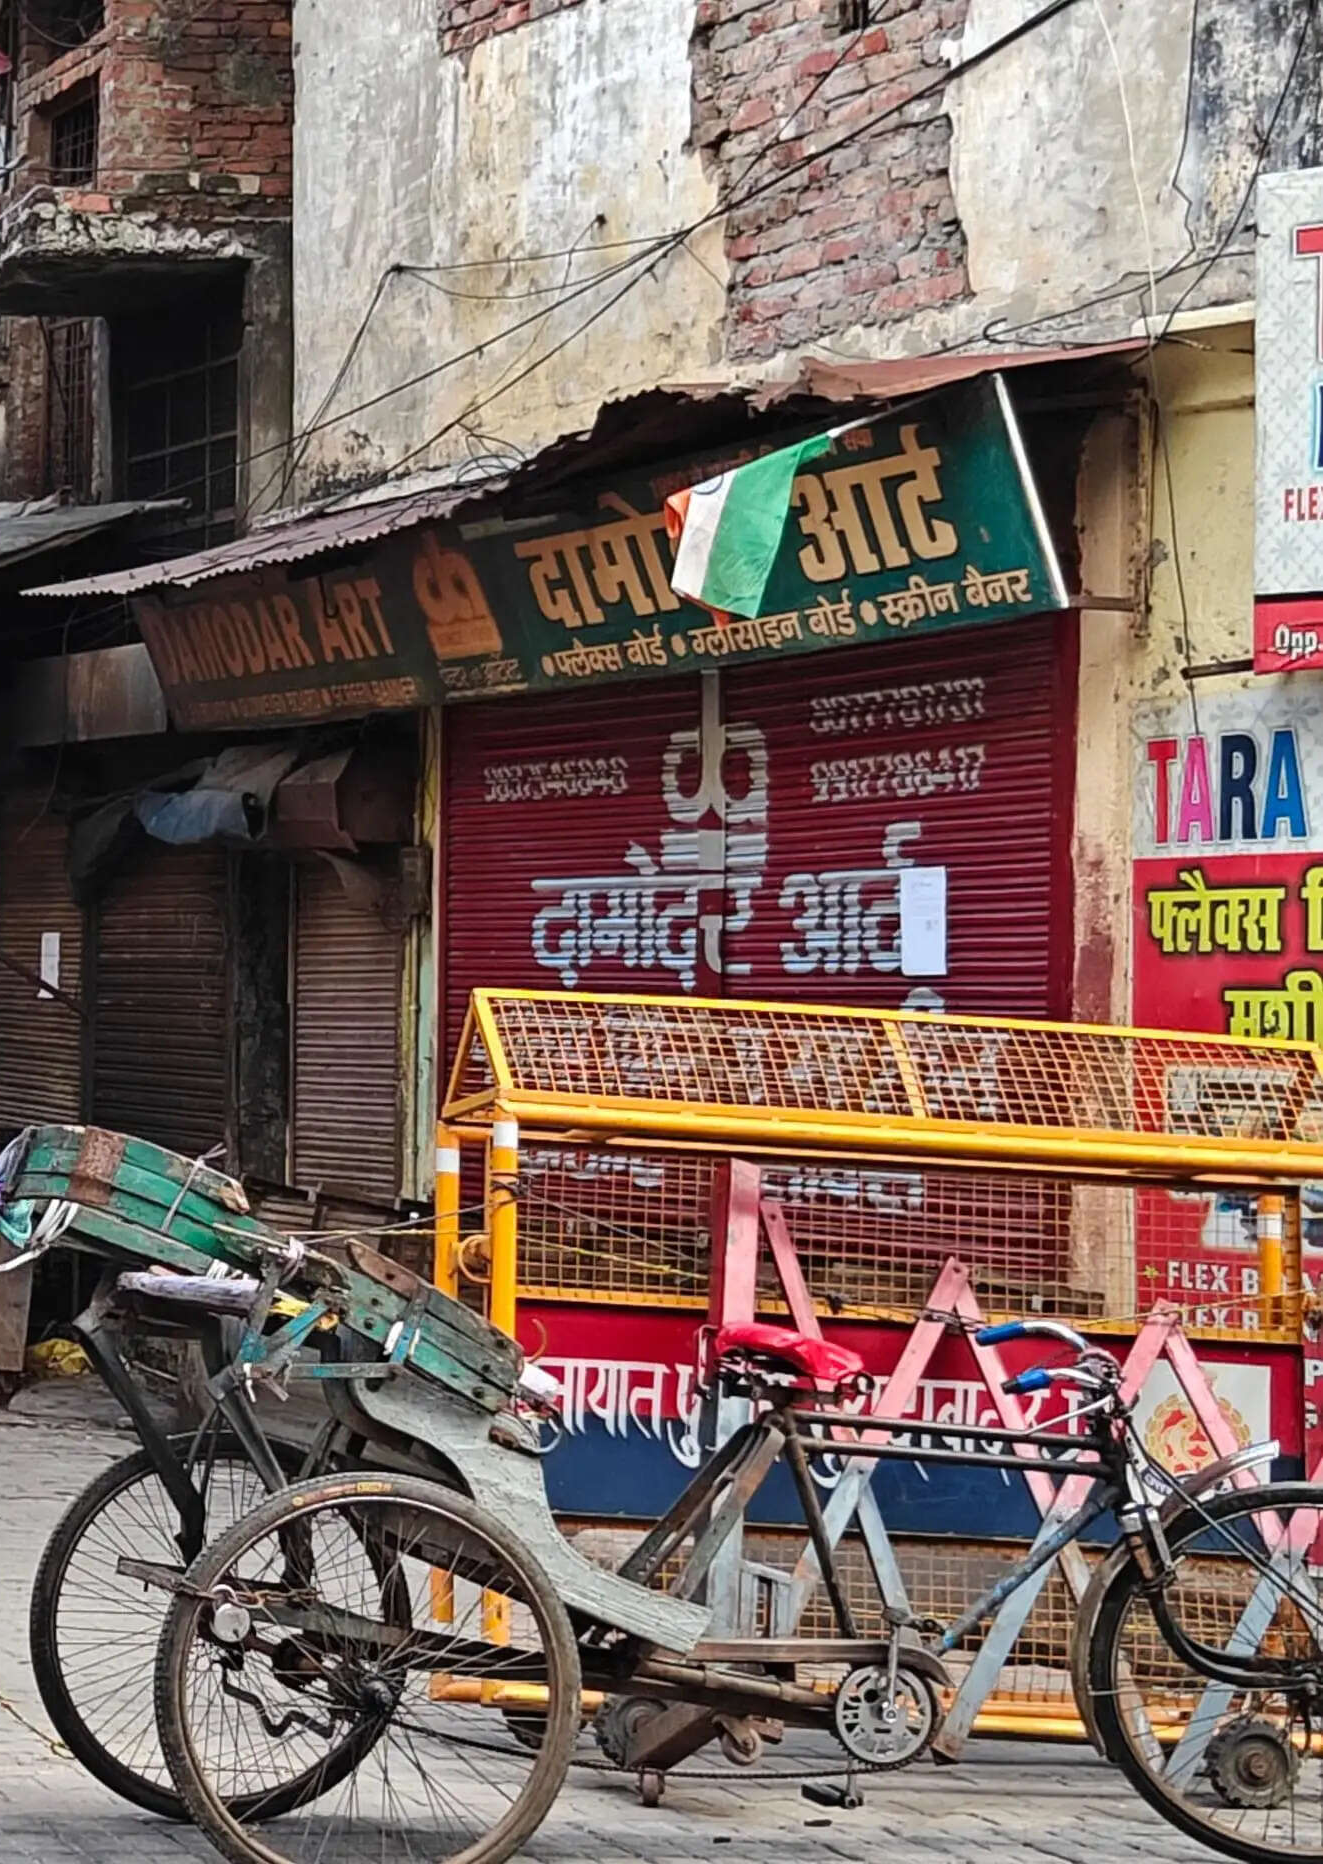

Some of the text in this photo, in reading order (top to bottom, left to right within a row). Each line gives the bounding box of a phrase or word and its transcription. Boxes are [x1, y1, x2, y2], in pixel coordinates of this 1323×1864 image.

[790, 424, 958, 584] आर्ट
[1146, 727, 1311, 847] TARA
[1148, 869, 1286, 953] फ्लैक्स
[1167, 1260, 1230, 1293] FLEX
